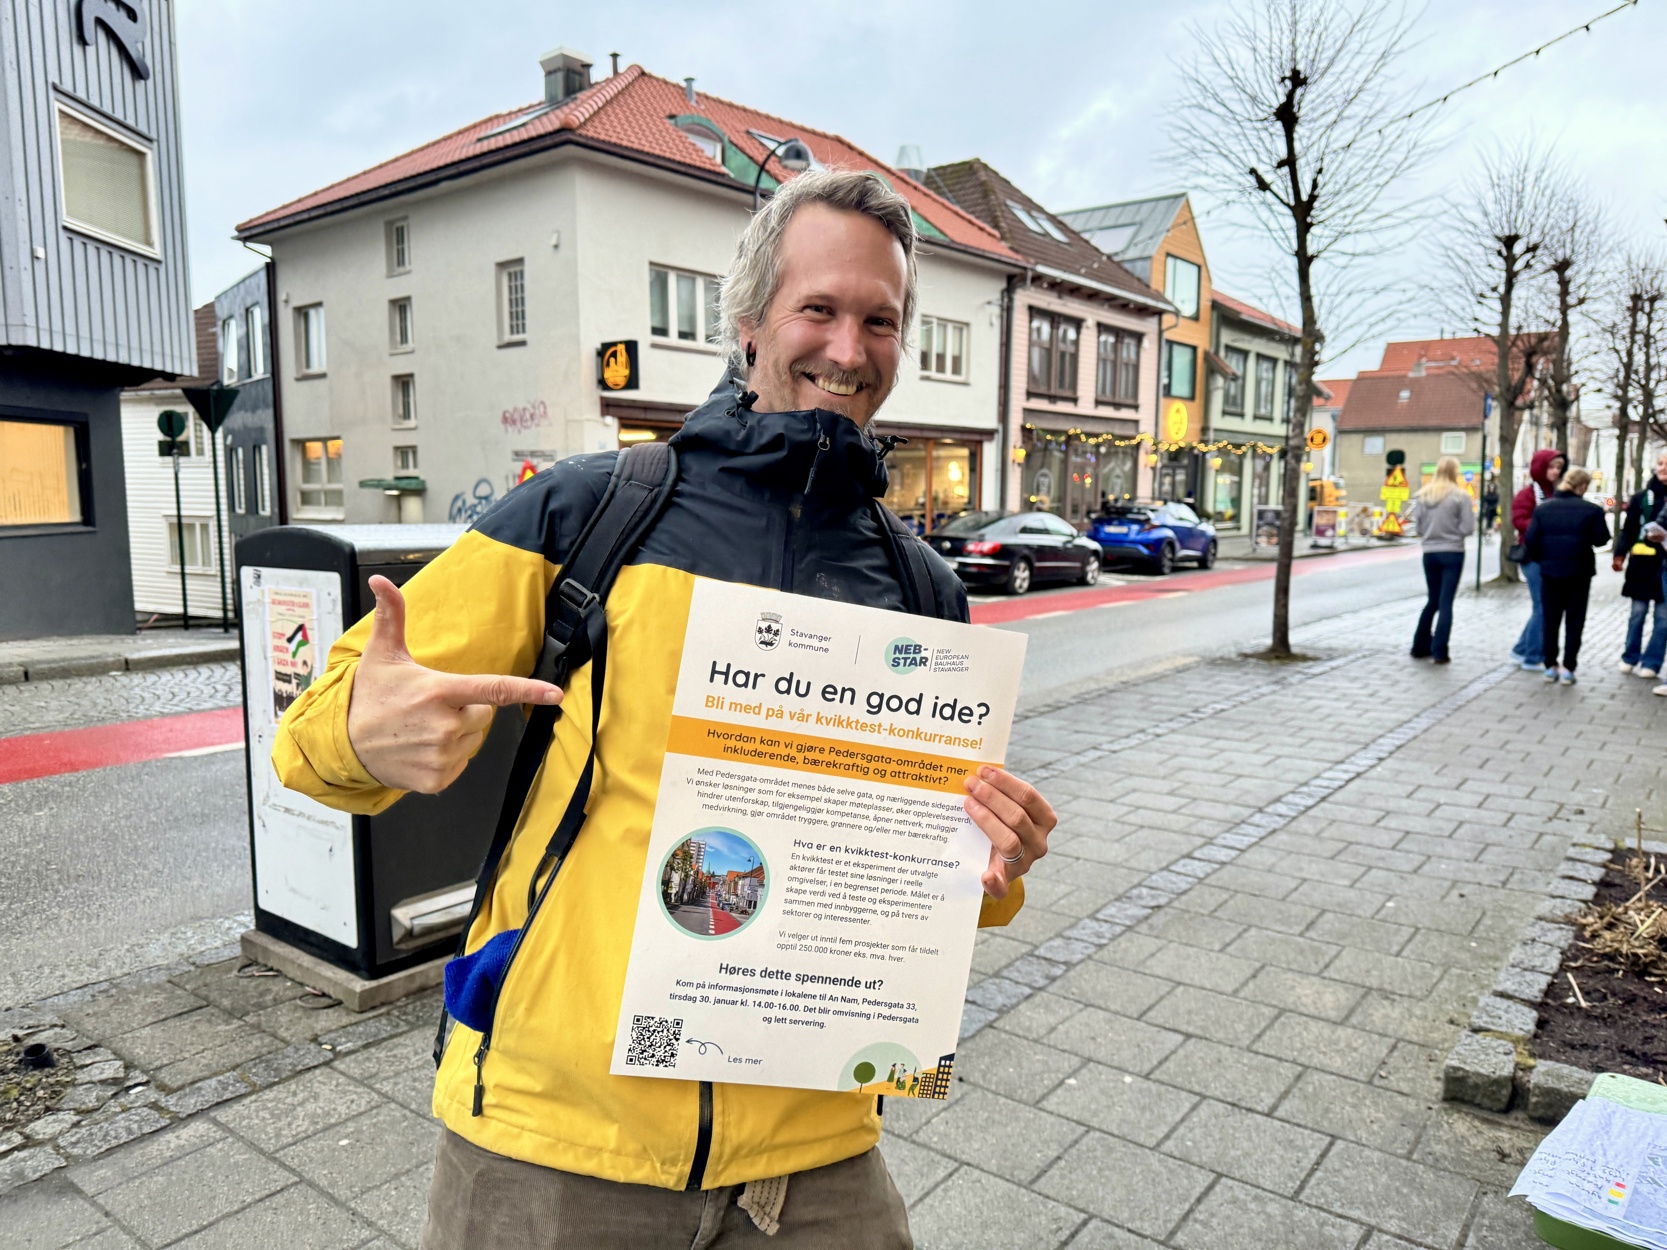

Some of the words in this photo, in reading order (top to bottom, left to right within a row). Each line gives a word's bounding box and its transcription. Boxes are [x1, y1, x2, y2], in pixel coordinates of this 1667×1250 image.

[787, 639, 829, 653] kommune
[790, 628, 831, 642] Stavanger
[891, 656, 929, 667] STAR
[893, 644, 929, 655] NEB-
[708, 660, 766, 690] Har
[774, 671, 811, 698] du
[820, 683, 856, 705] en
[865, 690, 923, 716] god
[931, 695, 990, 725] ide?
[704, 694, 725, 710] Bli
[728, 701, 762, 715] med
[764, 704, 784, 720] på
[788, 707, 812, 723] vår
[814, 711, 982, 750] kvikktest-konkurranse!
[706, 728, 756, 744] Hvordan
[759, 735, 780, 747] kan
[783, 740, 793, 749] vi
[795, 742, 825, 754] gjøre
[828, 746, 943, 772] Pedersgata-området
[946, 766, 968, 775] mer
[722, 743, 798, 764] inkluderende,
[802, 755, 869, 775] bærekraftig
[872, 767, 887, 778] og
[889, 770, 948, 785] attraktivt?
[694, 779, 720, 788] ønsker
[721, 781, 756, 794] løsninger
[775, 789, 786, 797] for
[786, 791, 822, 803] eksempel
[823, 796, 848, 806] skaper
[848, 801, 894, 813] møteplasser,
[895, 807, 911, 815] øker
[696, 767, 714, 776] Med
[715, 769, 789, 787] Pedersgata-området
[790, 782, 815, 790] menes
[816, 784, 835, 793] både
[836, 788, 855, 796] selve
[856, 791, 873, 800] gata,
[875, 794, 885, 802] og
[885, 795, 929, 807] nærliggende
[696, 789, 723, 800] hindrer
[724, 794, 770, 807] utenforskap,
[771, 800, 824, 814] tilgjengeliggjør
[825, 807, 870, 821] kompetanse,
[872, 813, 893, 823] åpner
[893, 818, 923, 828] nettverk,
[924, 823, 958, 833] muliggjør
[701, 803, 748, 816] medvirkning,
[749, 808, 764, 817] gjør
[765, 812, 796, 821] området
[798, 815, 828, 826] tryggere,
[830, 820, 862, 830] grønnere
[863, 825, 891, 834] og/eller
[790, 852, 800, 860] En
[801, 853, 833, 864] kvikktest
[852, 860, 895, 873] eksperiment
[896, 866, 909, 874] der
[909, 869, 938, 879] utvalgte
[793, 838, 813, 849] Hva
[844, 844, 960, 869] kvikktest-konkurranse?
[787, 875, 828, 887] omgivelser,
[843, 881, 879, 892] begrenset
[880, 887, 908, 896] periode.
[910, 890, 930, 899] Målet
[788, 863, 814, 873] aktører
[816, 866, 826, 874] får
[827, 868, 848, 877] testet
[849, 871, 864, 879] sine
[865, 872, 898, 884] løsninger
[903, 879, 923, 887] reelle
[783, 898, 815, 907] sammen
[833, 902, 878, 915] innbyggerne,
[879, 909, 889, 917] og
[890, 909, 900, 918] på
[901, 911, 918, 920] tvers
[785, 885, 807, 895] skape
[848, 893, 866, 902] teste
[867, 897, 877, 905] og
[878, 897, 932, 910] eksperimentere
[781, 908, 812, 917] sektorer
[812, 912, 822, 921] og
[823, 912, 871, 925] interessenter.
[776, 942, 797, 951] opptil
[798, 943, 828, 954] 250.000
[828, 946, 852, 956] kroner
[853, 950, 867, 958] eks.
[787, 931, 809, 941] velger
[819, 934, 837, 943] inntil
[838, 936, 852, 945] fem
[853, 940, 890, 949] prosjekter
[907, 944, 918, 952] får
[919, 946, 938, 955] tildelt
[718, 962, 756, 977] Høres
[759, 966, 791, 980] dette
[794, 972, 861, 988] spennende
[864, 979, 883, 990] ut?
[675, 978, 694, 987] Kom
[695, 980, 706, 990] på
[707, 981, 779, 996] informasjonsmøte
[784, 989, 817, 1000] lokalene
[827, 994, 838, 1002] An
[840, 995, 859, 1005] Nam,
[861, 997, 904, 1009] Pedersgata
[905, 1002, 917, 1011] 33,
[669, 992, 697, 1003] tirsdag
[698, 994, 711, 1003] 30.
[712, 996, 738, 1005] januar
[739, 998, 749, 1006] kl.
[752, 1000, 801, 1011] 14.00-16.00.
[802, 1004, 816, 1013] Det
[817, 1006, 831, 1014] blir
[832, 1009, 871, 1020] omvisning
[876, 1012, 919, 1024] Pedersgata
[761, 1016, 772, 1024] og
[773, 1015, 787, 1024] lett
[788, 1018, 826, 1029] servering.
[727, 1055, 742, 1063] Les
